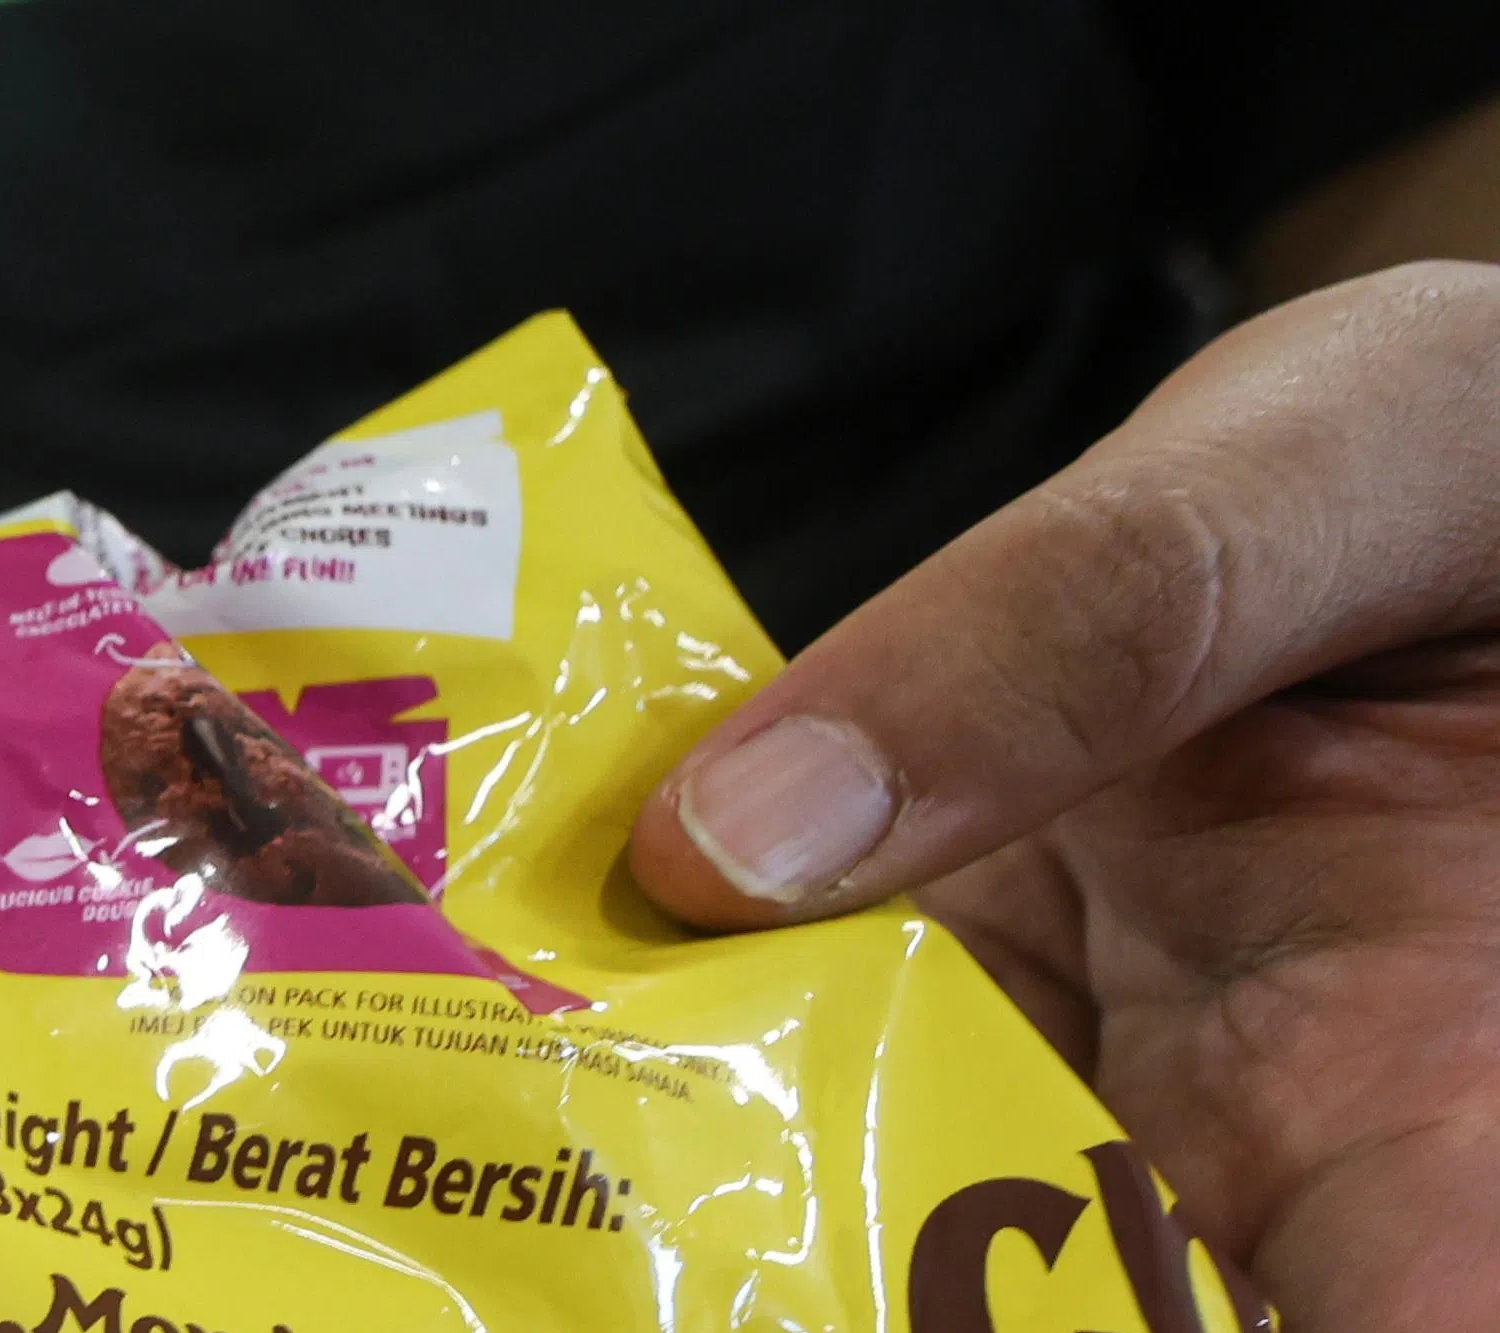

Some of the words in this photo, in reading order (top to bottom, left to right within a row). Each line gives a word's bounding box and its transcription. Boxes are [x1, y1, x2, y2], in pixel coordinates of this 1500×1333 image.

[284, 988, 347, 1011] PACK
[356, 991, 403, 1013] FOR
[268, 1016, 313, 1038] PEK
[322, 1020, 406, 1047] UNTUK
[414, 1027, 510, 1057] TUJUAN
[187, 1112, 372, 1203] Berat
[383, 1135, 631, 1233] Bersih:
